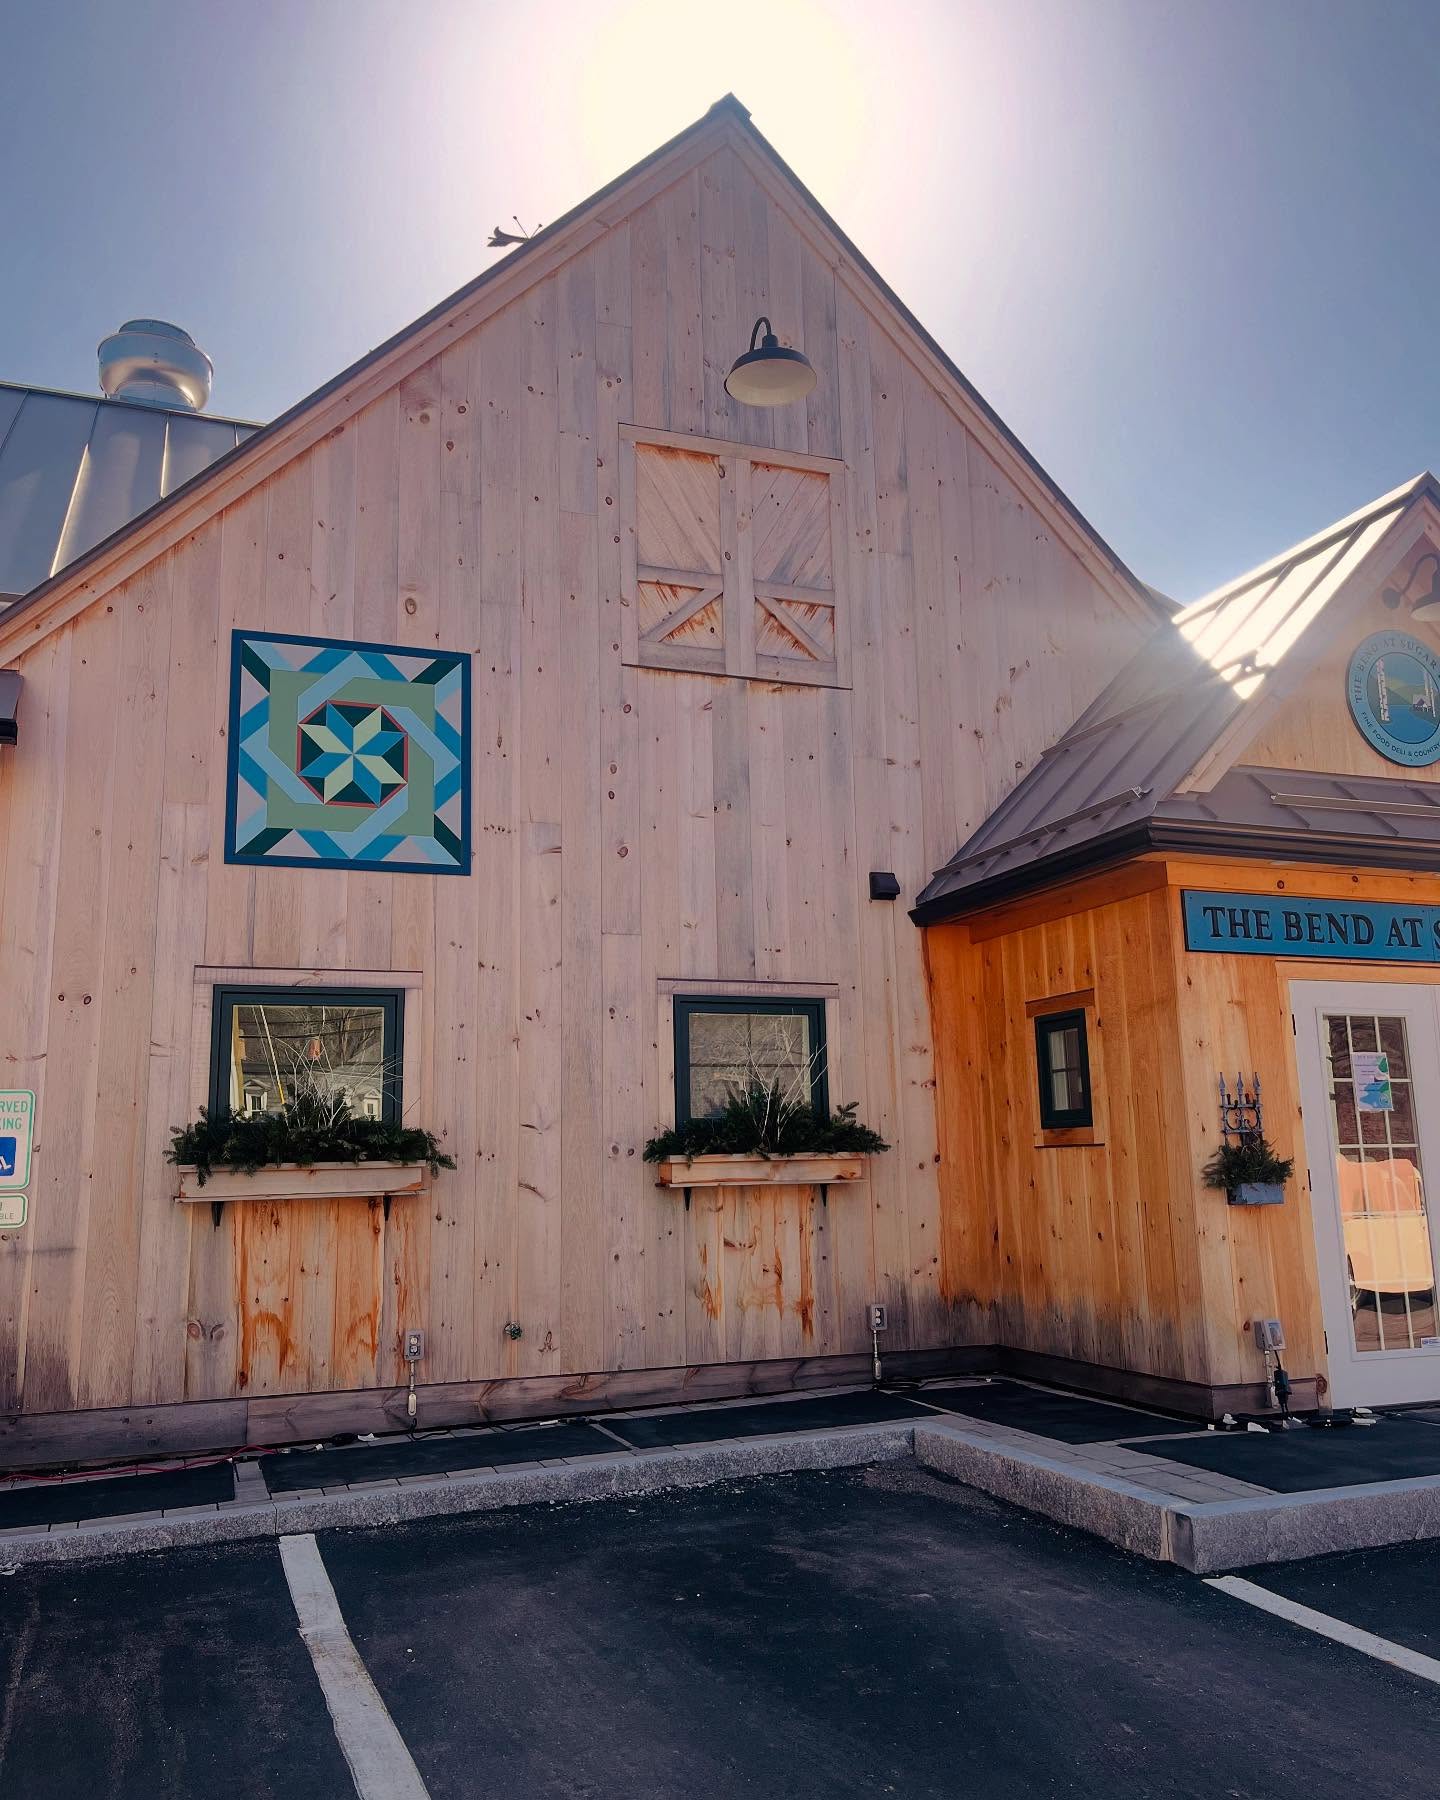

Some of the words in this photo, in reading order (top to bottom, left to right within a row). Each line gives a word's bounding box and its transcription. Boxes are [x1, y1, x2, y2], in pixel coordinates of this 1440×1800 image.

[1354, 674, 1362, 703] THE
[1383, 637, 1395, 648] AT
[1400, 639, 1437, 670] SUGAR
[1361, 711, 1373, 728] FINE
[1372, 729, 1391, 748] FOOD
[1391, 745, 1406, 756] DELI
[1202, 906, 1273, 941] THE
[1281, 910, 1375, 945] BEND
[1385, 917, 1424, 948] AT
[0, 1117, 23, 1130] ING
